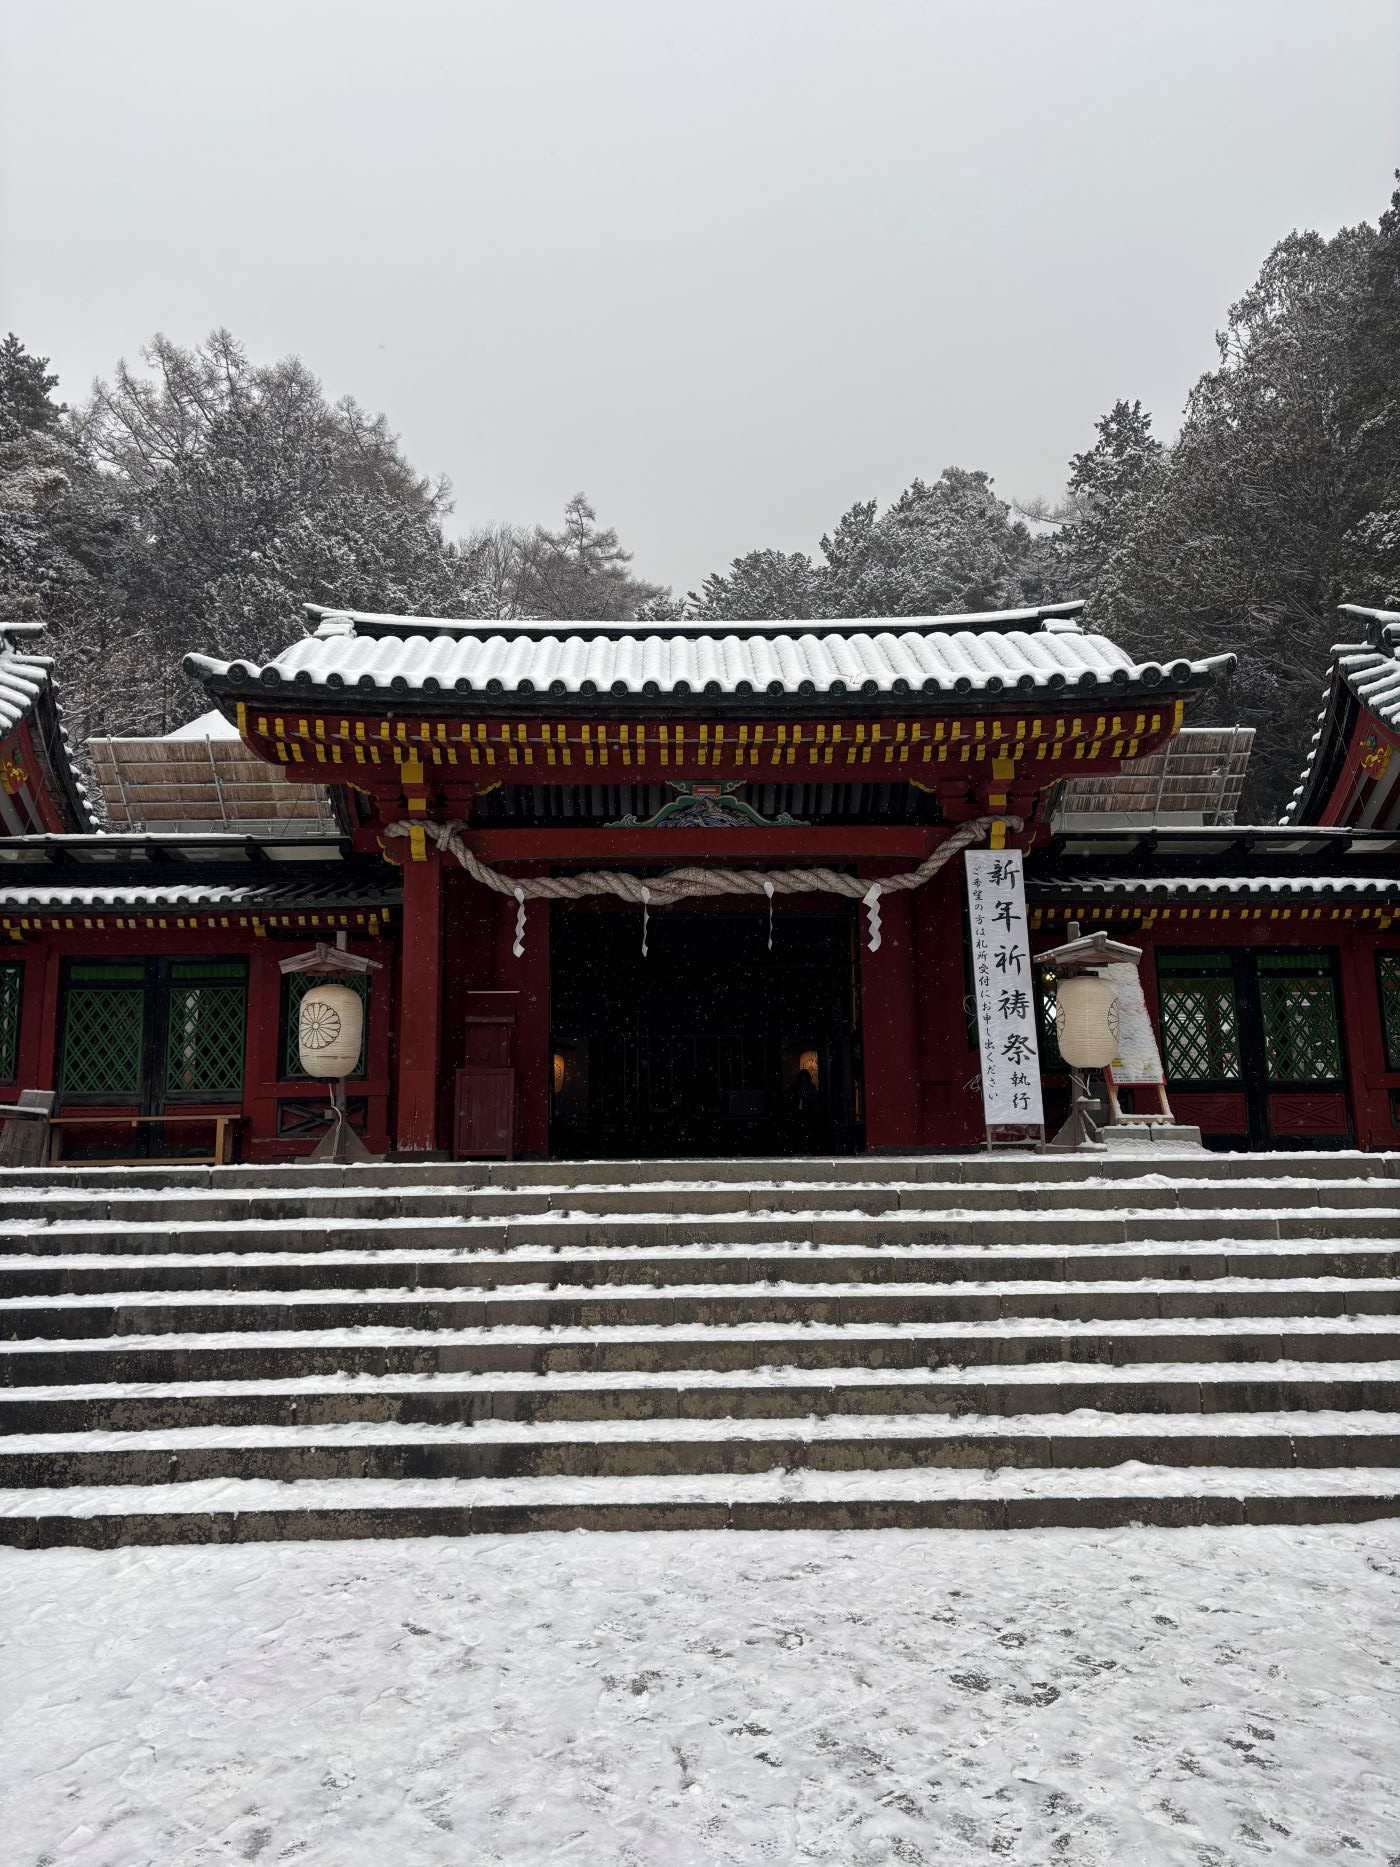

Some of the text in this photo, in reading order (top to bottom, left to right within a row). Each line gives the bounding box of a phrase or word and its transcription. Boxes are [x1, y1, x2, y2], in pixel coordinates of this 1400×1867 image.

[972, 865, 999, 1100] ご希望の方は札所受付にお申し出ください
[986, 859, 1037, 1111] 新年祈祷祭執行
